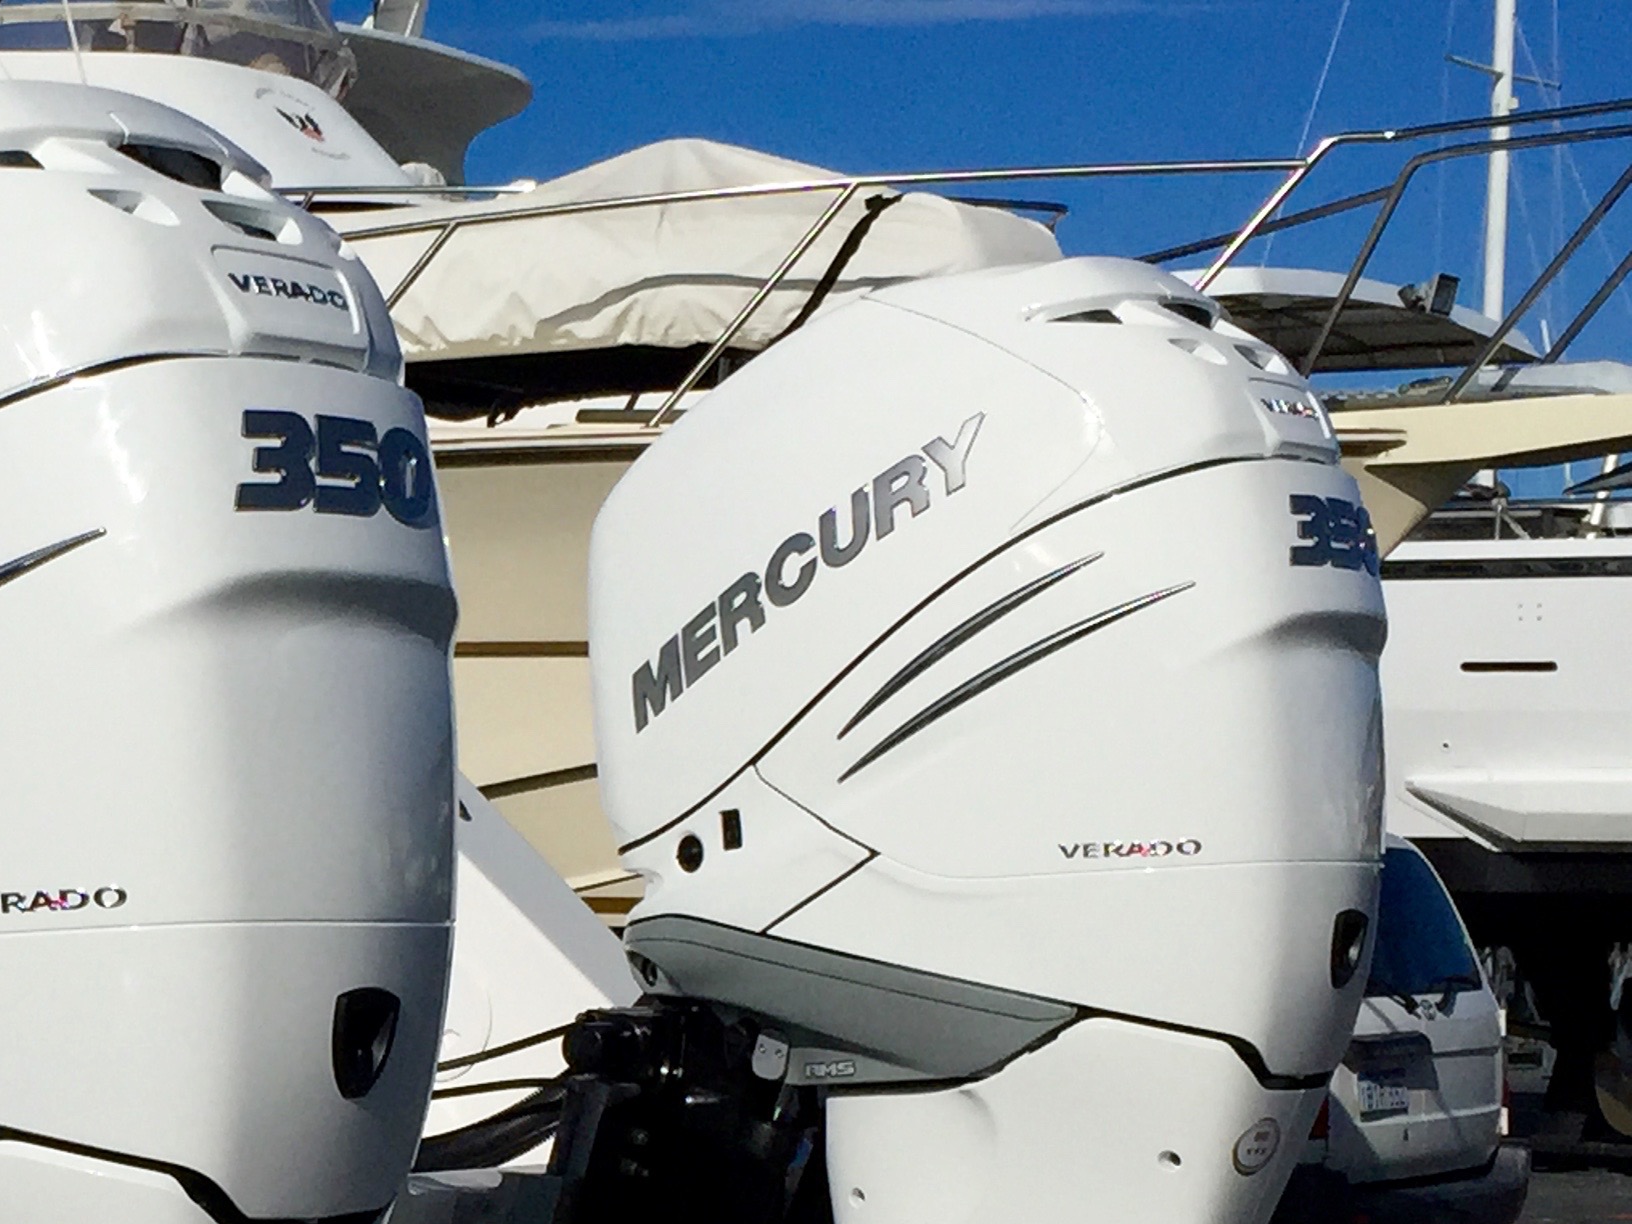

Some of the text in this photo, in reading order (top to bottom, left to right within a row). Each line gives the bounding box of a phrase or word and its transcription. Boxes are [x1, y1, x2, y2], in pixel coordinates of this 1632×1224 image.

[228, 272, 350, 311] VERADO
[234, 408, 439, 530] 350
[631, 410, 987, 735] MERCURY
[1057, 838, 1203, 860] VERADO
